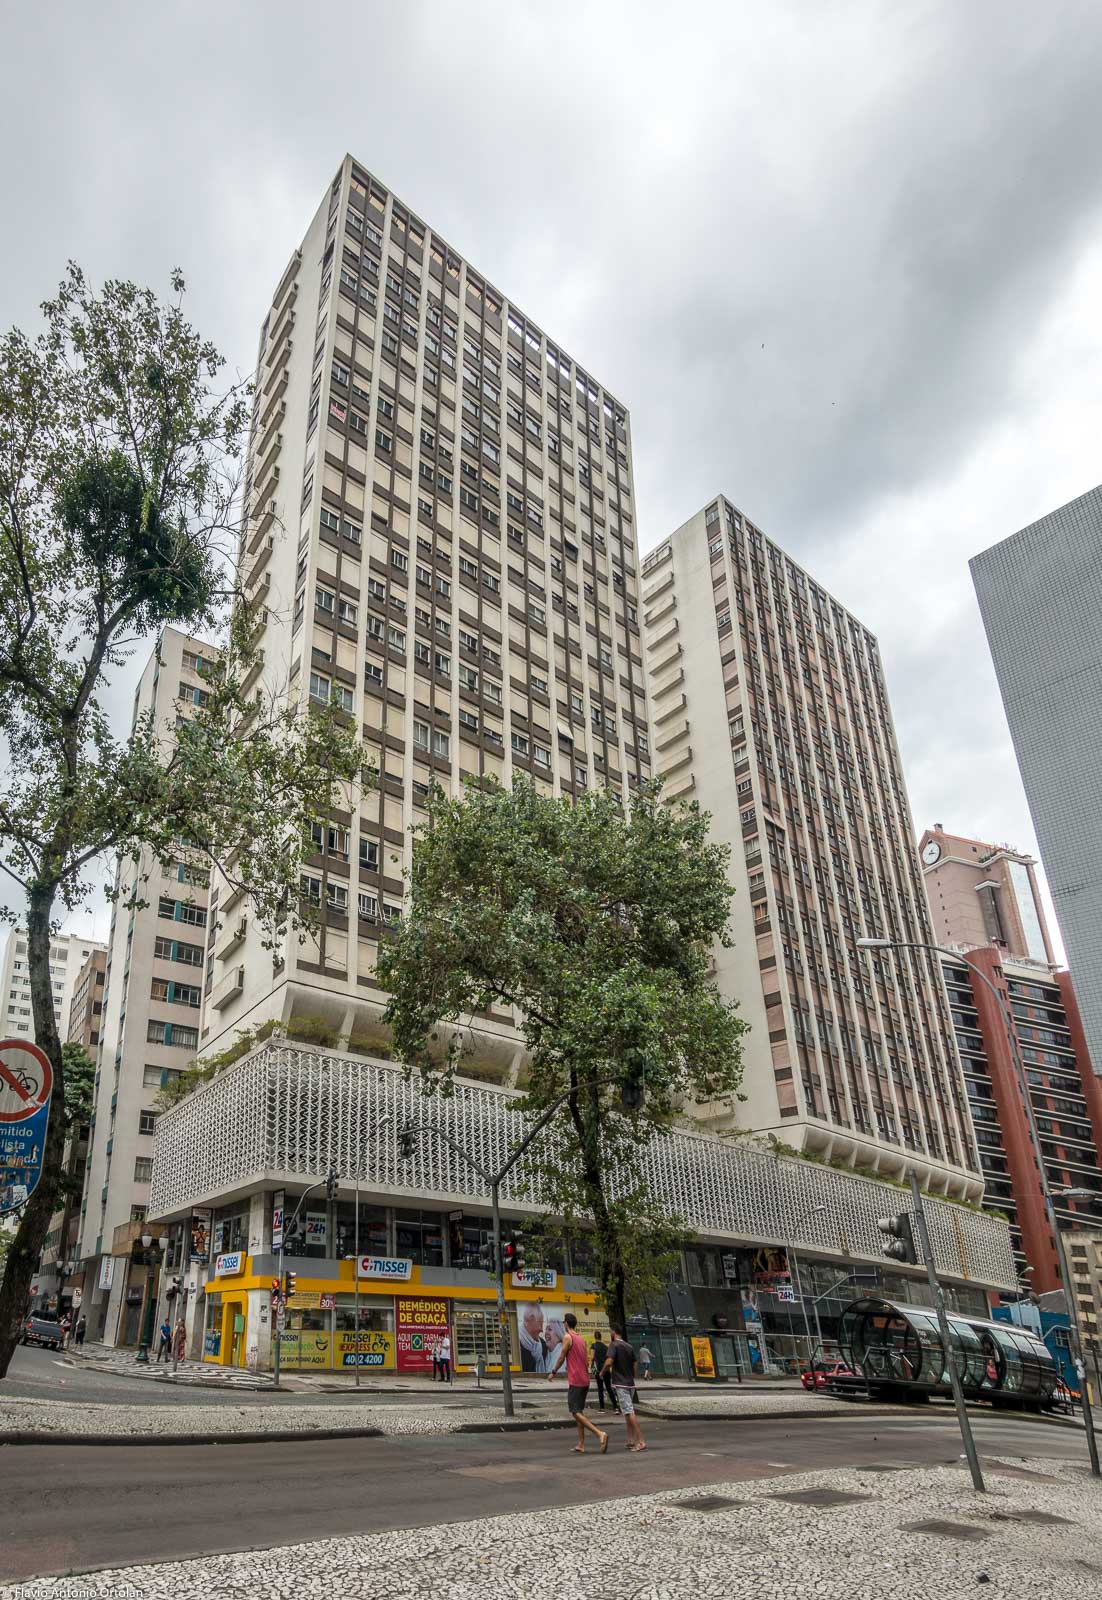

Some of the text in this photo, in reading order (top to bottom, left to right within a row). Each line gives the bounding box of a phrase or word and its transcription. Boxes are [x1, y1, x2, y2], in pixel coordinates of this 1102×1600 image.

[0, 1139, 25, 1150] lista
[373, 1260, 408, 1273] nissei
[399, 1300, 447, 1312] REMÉDIOS
[399, 1312, 448, 1325] DE GRAÇA
[398, 1333, 411, 1342] AQUI
[341, 1343, 371, 1351] EXPESS
[398, 1342, 411, 1351] TEM
[345, 1354, 383, 1365] 402 4200
